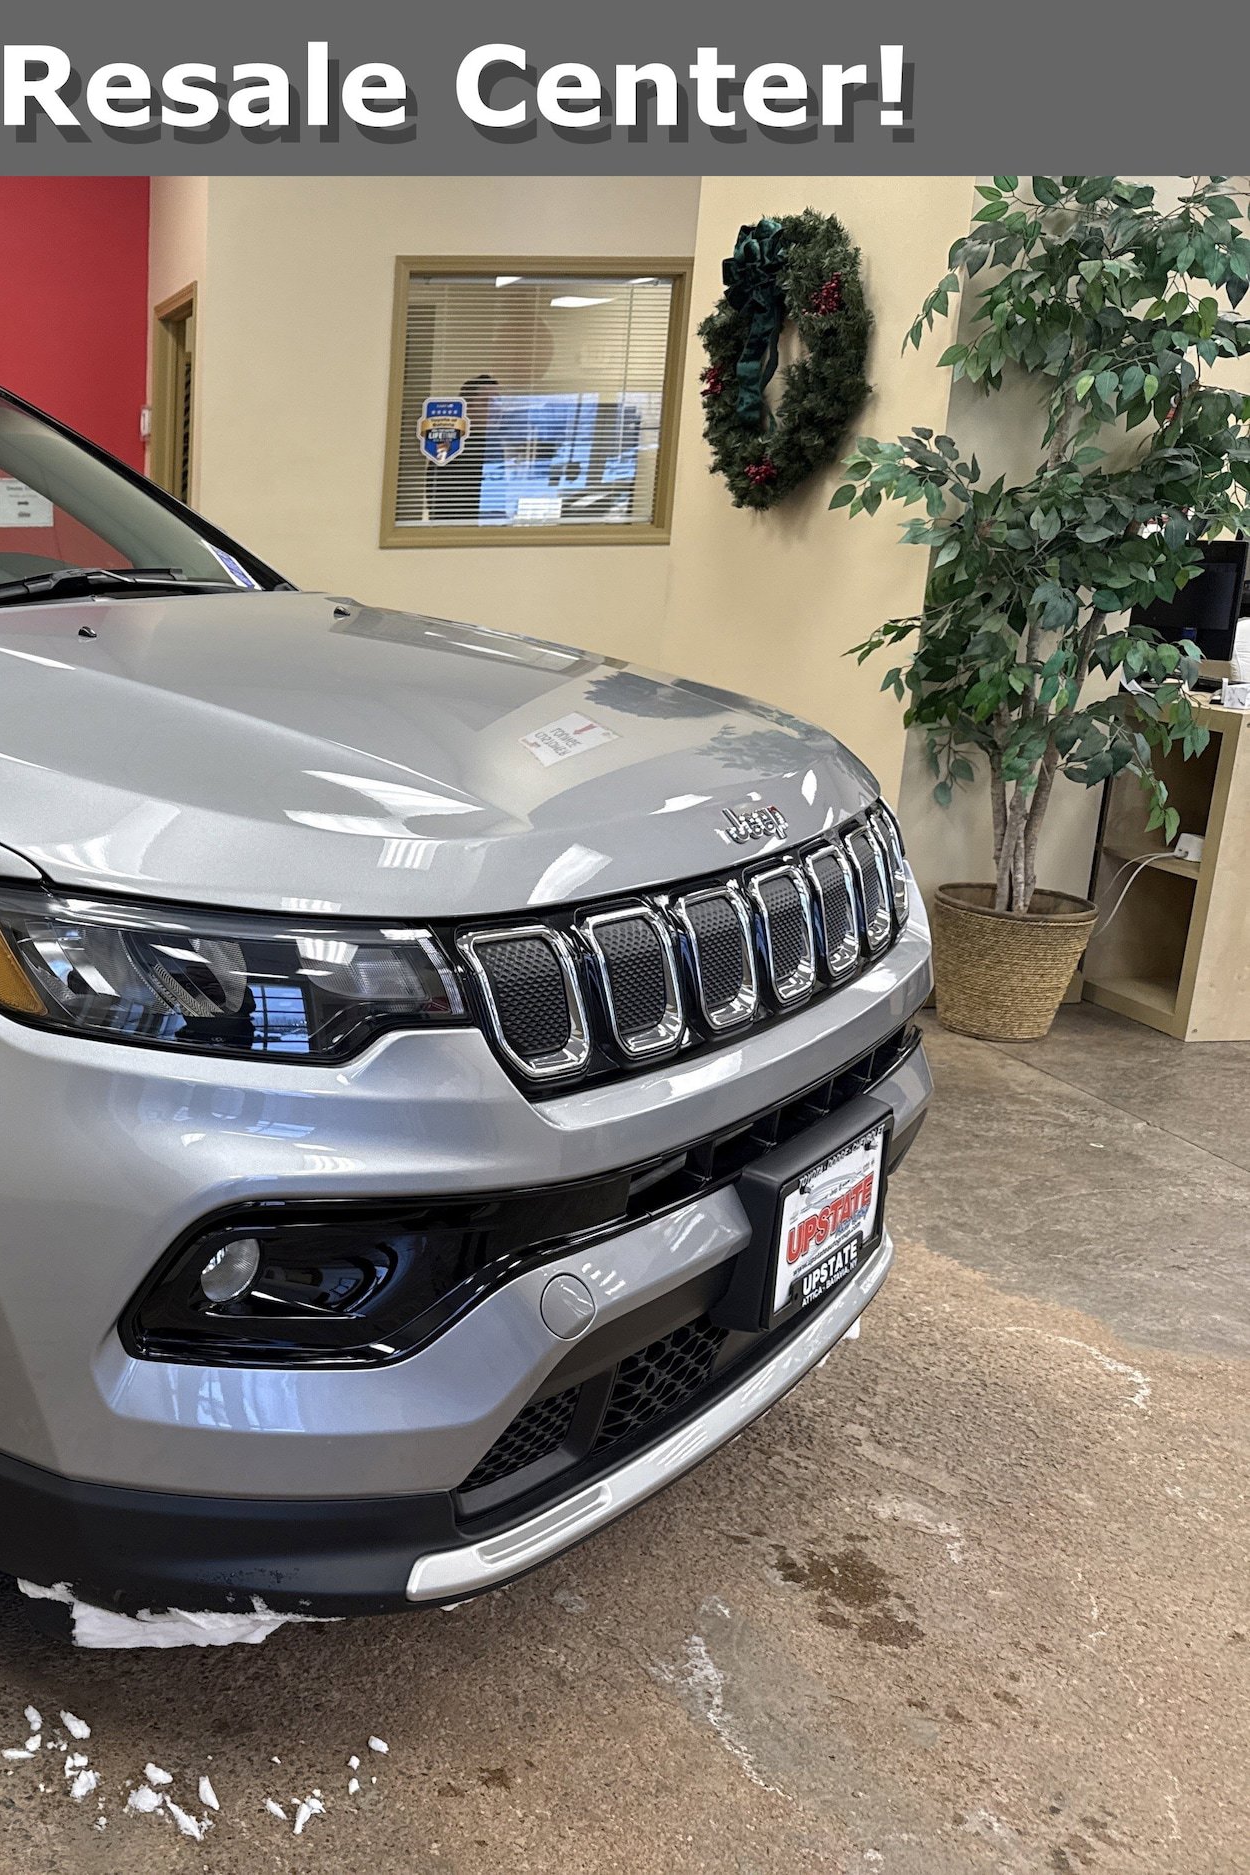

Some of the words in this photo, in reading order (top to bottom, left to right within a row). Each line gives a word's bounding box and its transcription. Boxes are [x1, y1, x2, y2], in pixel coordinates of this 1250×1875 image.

[720, 805, 789, 845] Jeep
[786, 1172, 874, 1265] UPSTATE
[803, 1238, 858, 1296] UPSTATE
